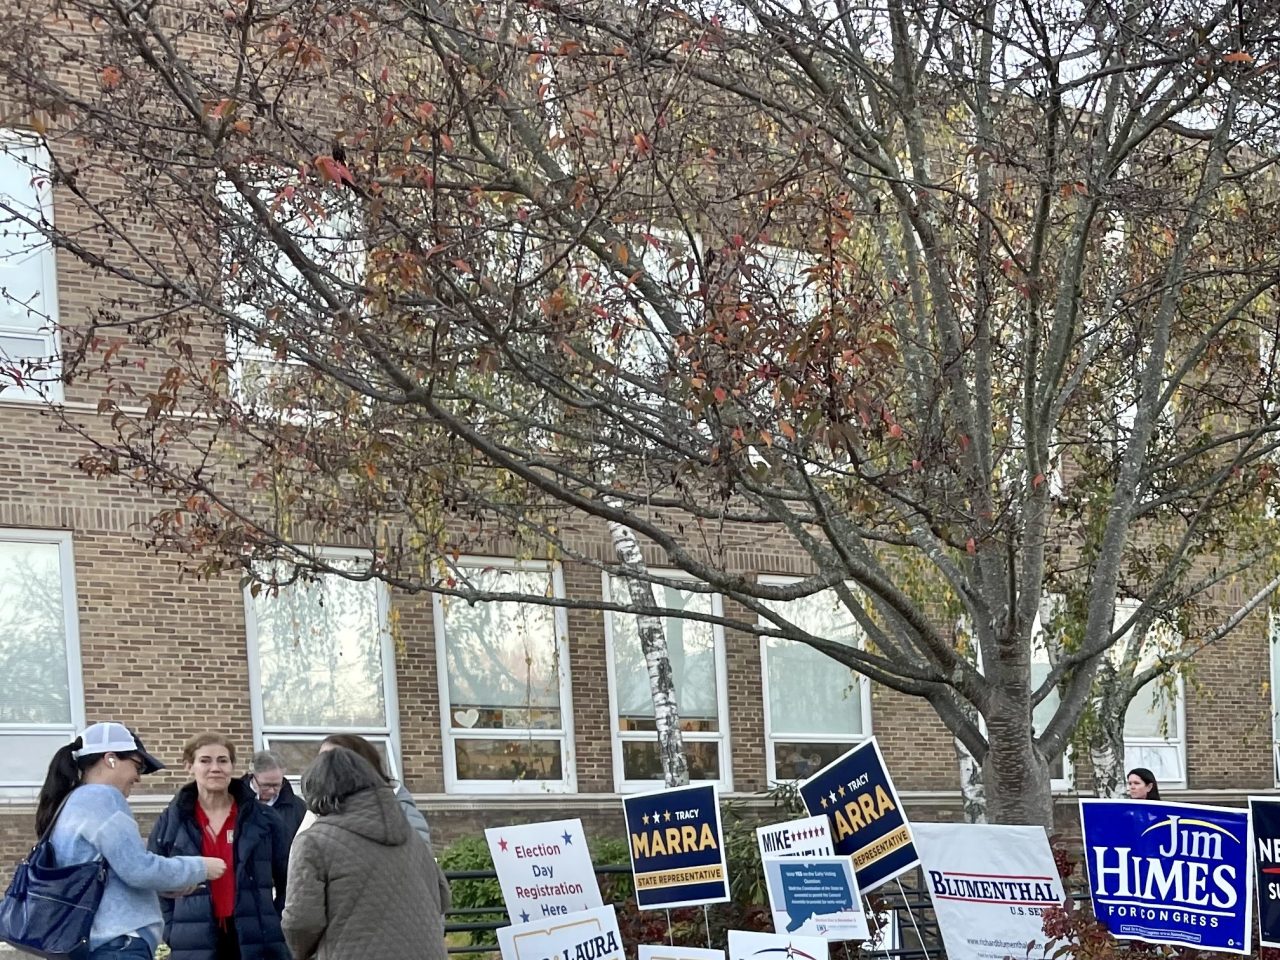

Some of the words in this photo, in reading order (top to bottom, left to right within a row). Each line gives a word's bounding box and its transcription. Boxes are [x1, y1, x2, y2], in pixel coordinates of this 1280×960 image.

[847, 772, 869, 792] TRACY
[675, 808, 699, 821] TRACY
[632, 822, 717, 859] MARRA
[762, 829, 792, 853] MIKE
[1159, 814, 1223, 860] Jim
[515, 843, 561, 859] Election
[853, 830, 909, 868] REPRESENTATIVE
[532, 864, 553, 878] Day
[637, 876, 657, 887] STATE
[658, 869, 721, 884] REPRESENTATIVE
[1092, 846, 1237, 909] HIMES
[515, 881, 583, 900] Registration
[928, 870, 1060, 902] BLUMENTHAL
[541, 903, 568, 916] Here
[1010, 906, 1026, 916] U.S.
[966, 938, 1043, 950] www.richardblumenthalom
